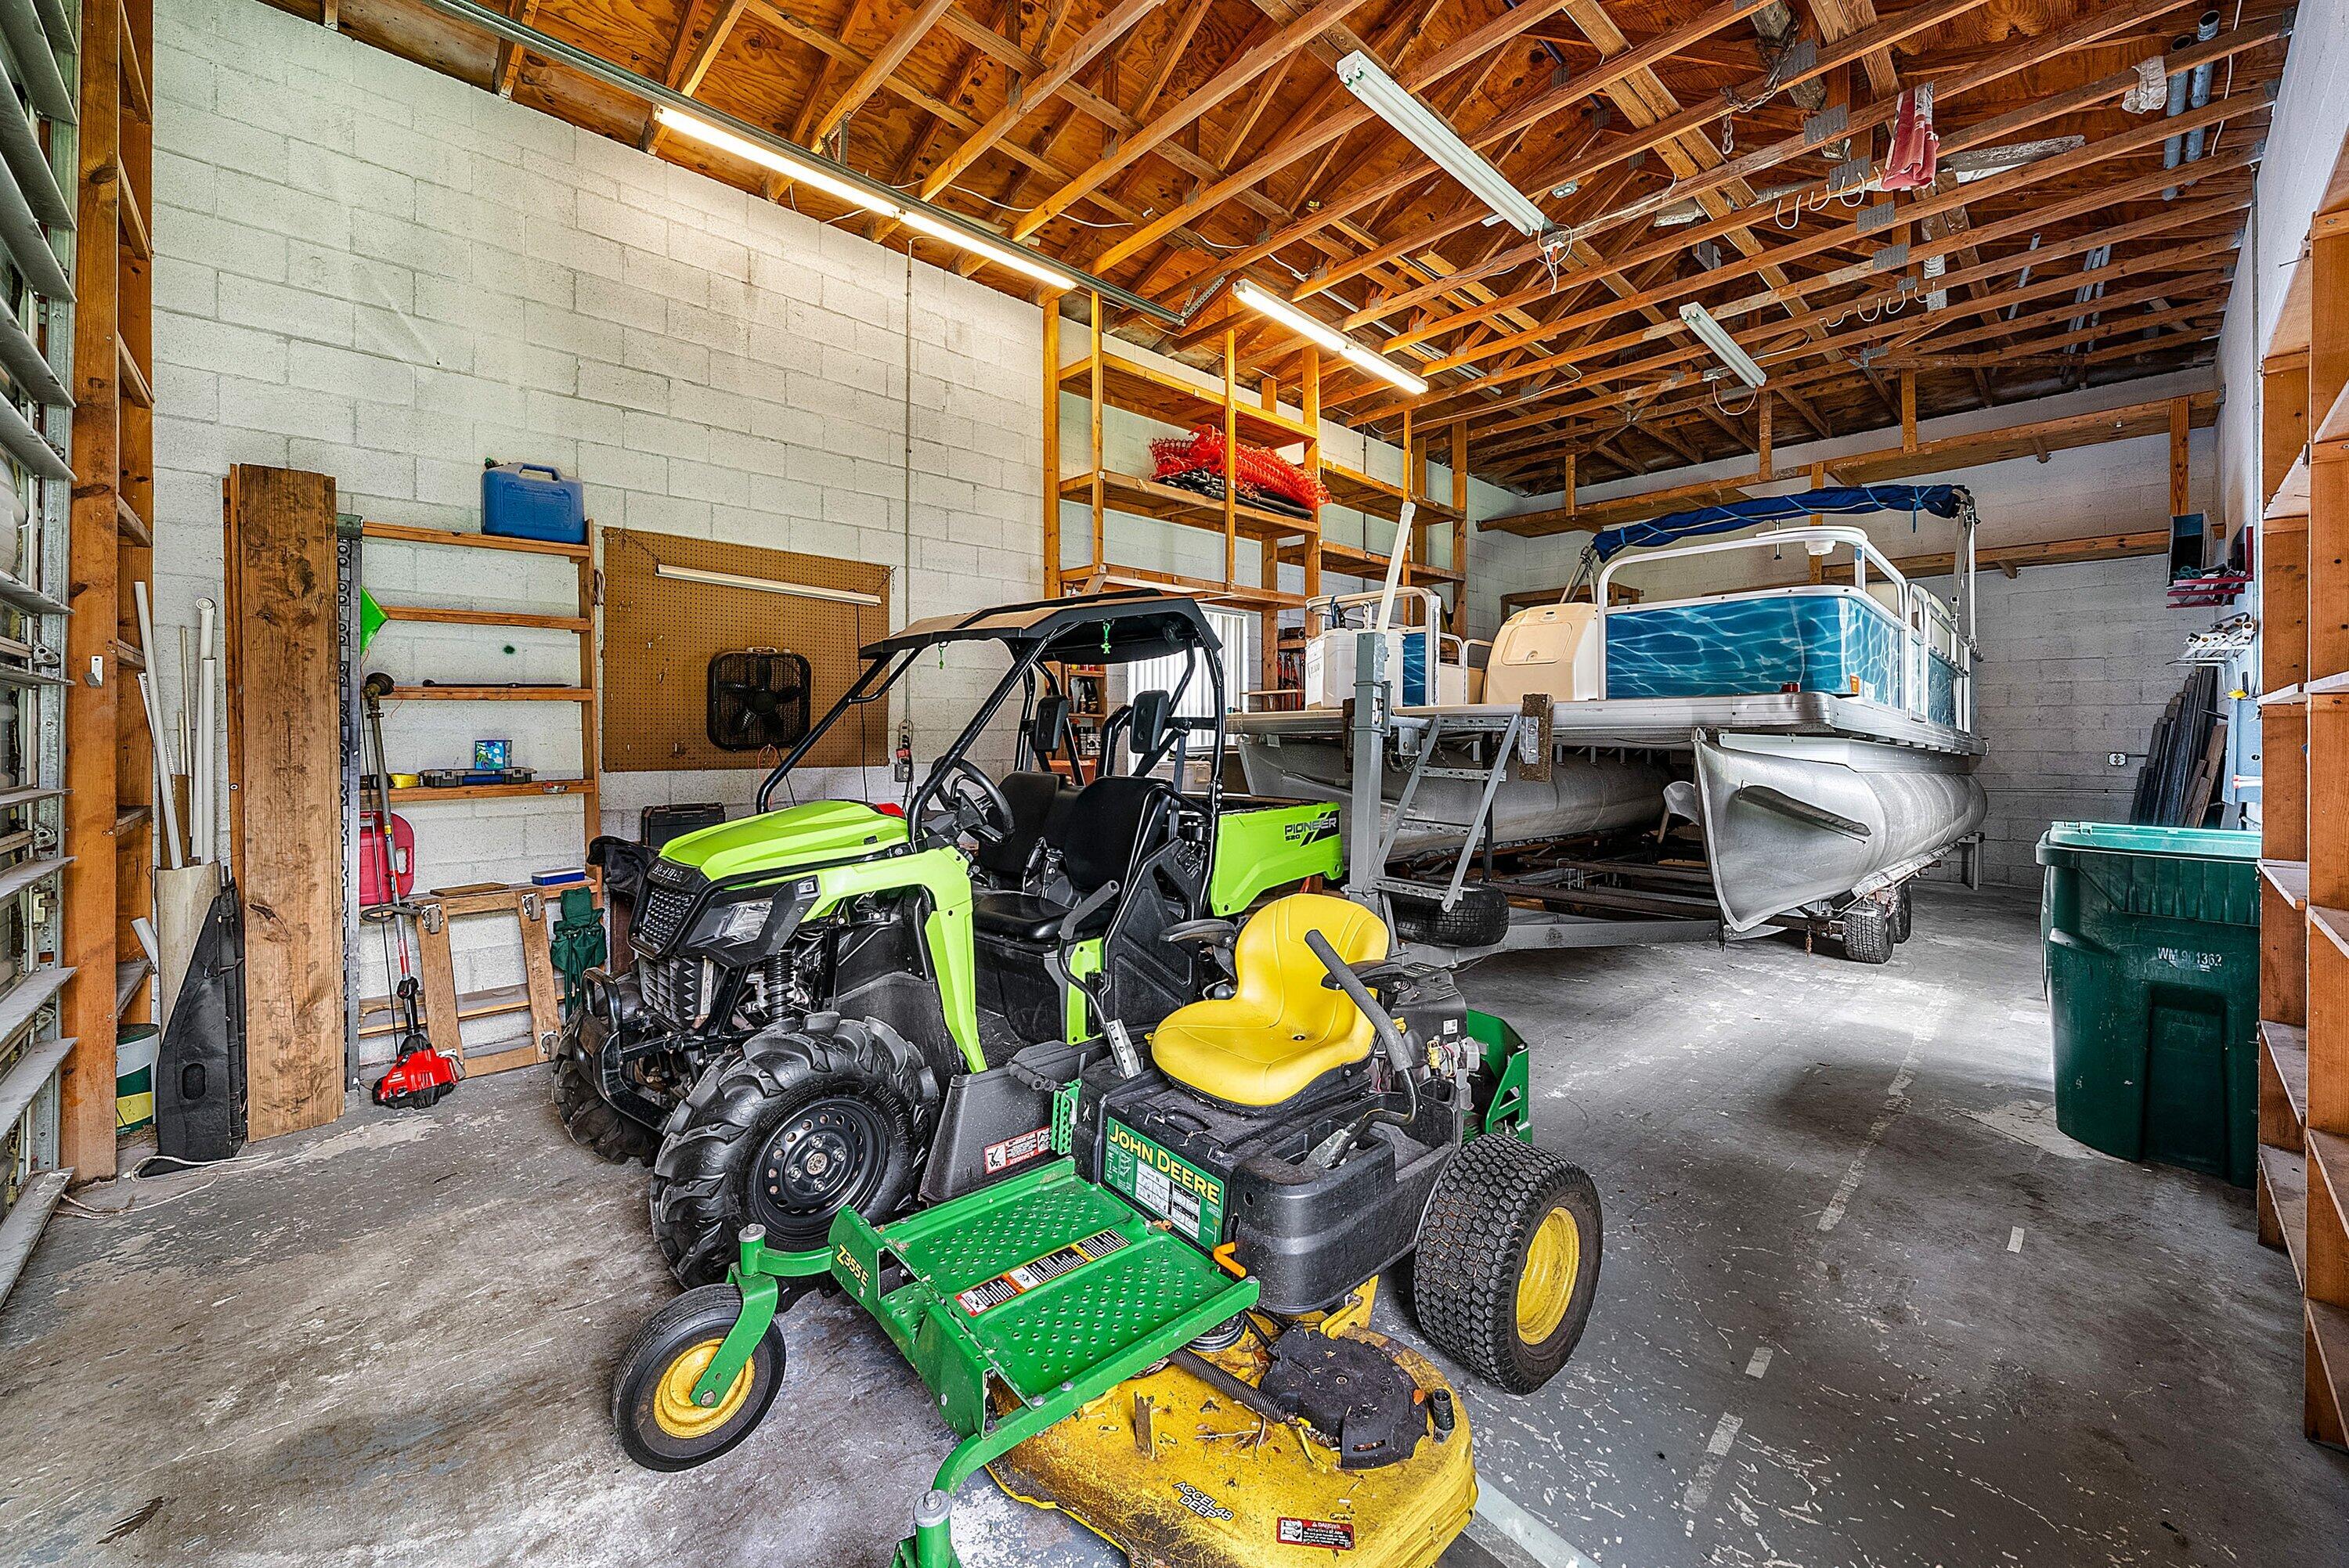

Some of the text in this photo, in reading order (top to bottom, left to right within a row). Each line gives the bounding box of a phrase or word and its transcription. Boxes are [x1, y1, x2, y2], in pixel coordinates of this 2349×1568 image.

[1285, 817, 1337, 835] PIONEER
[1110, 1123, 1154, 1166] JOHN
[1156, 1147, 1221, 1206] DEERE
[1172, 1481, 1218, 1510] ACCEL
[1178, 1494, 1235, 1521] DEEP 48
